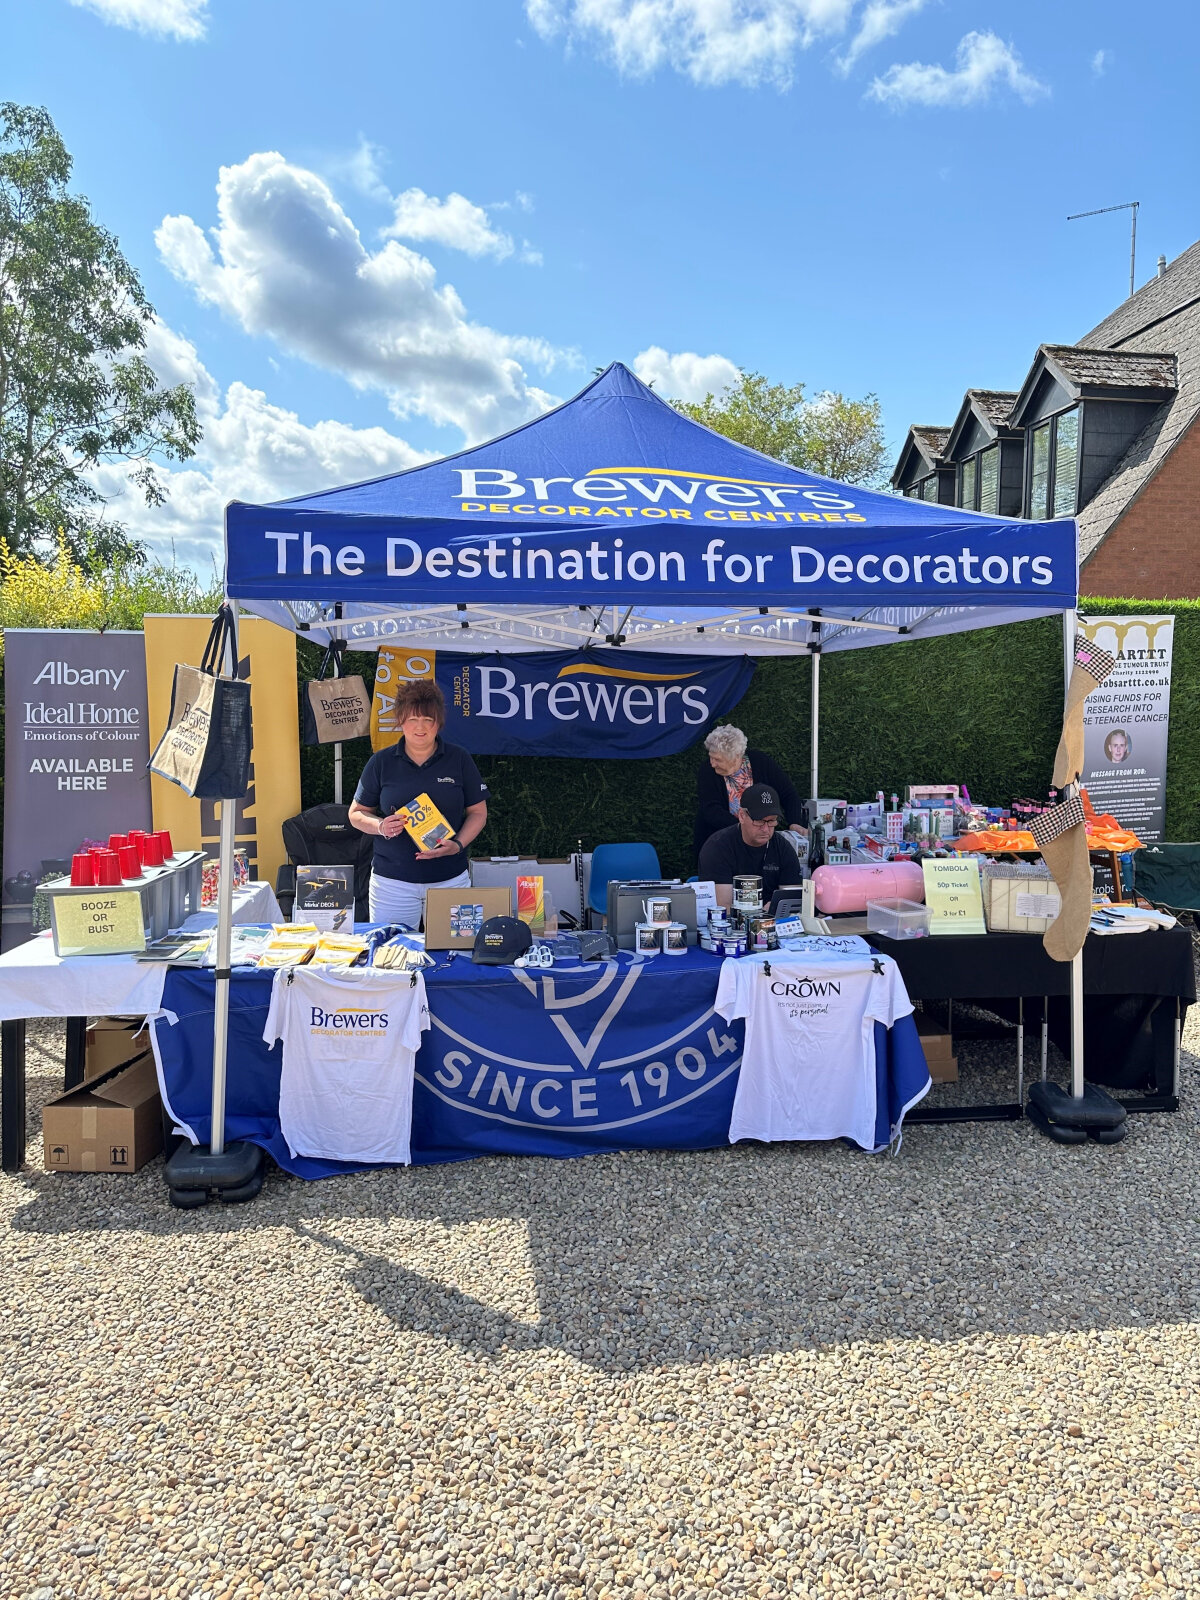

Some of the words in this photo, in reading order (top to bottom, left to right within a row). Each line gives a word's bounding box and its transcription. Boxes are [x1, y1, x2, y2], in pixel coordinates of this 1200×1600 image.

[451, 468, 856, 511] Brewers
[461, 502, 694, 520] DECORATOR
[704, 510, 867, 523] CENTRES
[264, 531, 365, 577] The
[386, 537, 686, 582] Destination
[702, 539, 773, 583] for
[791, 546, 1053, 585] Decorators
[1116, 649, 1166, 660] ARTTT
[375, 651, 395, 683] to
[32, 662, 126, 691] Albany
[453, 676, 462, 706] CENTRE
[475, 664, 709, 725] Brewers
[1085, 695, 1112, 703] AISING
[1114, 694, 1142, 702] FUNDS
[1143, 693, 1162, 701] FOR
[320, 695, 362, 711] Brewers
[1087, 705, 1131, 714] RESEARCH
[1132, 704, 1153, 712] INTO
[23, 702, 75, 724] Ideal
[77, 703, 139, 724] Home
[325, 707, 364, 719] DECORATOR
[331, 715, 359, 725] CENTRES
[1095, 715, 1133, 724] TEENAGE
[1134, 714, 1168, 722] CANCER
[24, 731, 83, 741] Emotions
[85, 731, 99, 741] of
[99, 731, 140, 741] Colour
[171, 737, 197, 757] CENTRES
[29, 758, 134, 773] AVAILABLE
[1091, 769, 1115, 778] MESSAGE
[57, 776, 107, 791] HERE
[81, 900, 117, 911] BOOZE
[92, 913, 108, 922] OR
[88, 924, 115, 934] BUST
[771, 979, 841, 998] CROWN
[310, 1006, 389, 1029] Brewers
[311, 1028, 353, 1037] DECORATOR
[355, 1029, 387, 1037] CENTRES
[434, 1050, 599, 1119] SINCE
[620, 1026, 738, 1107] 1904
